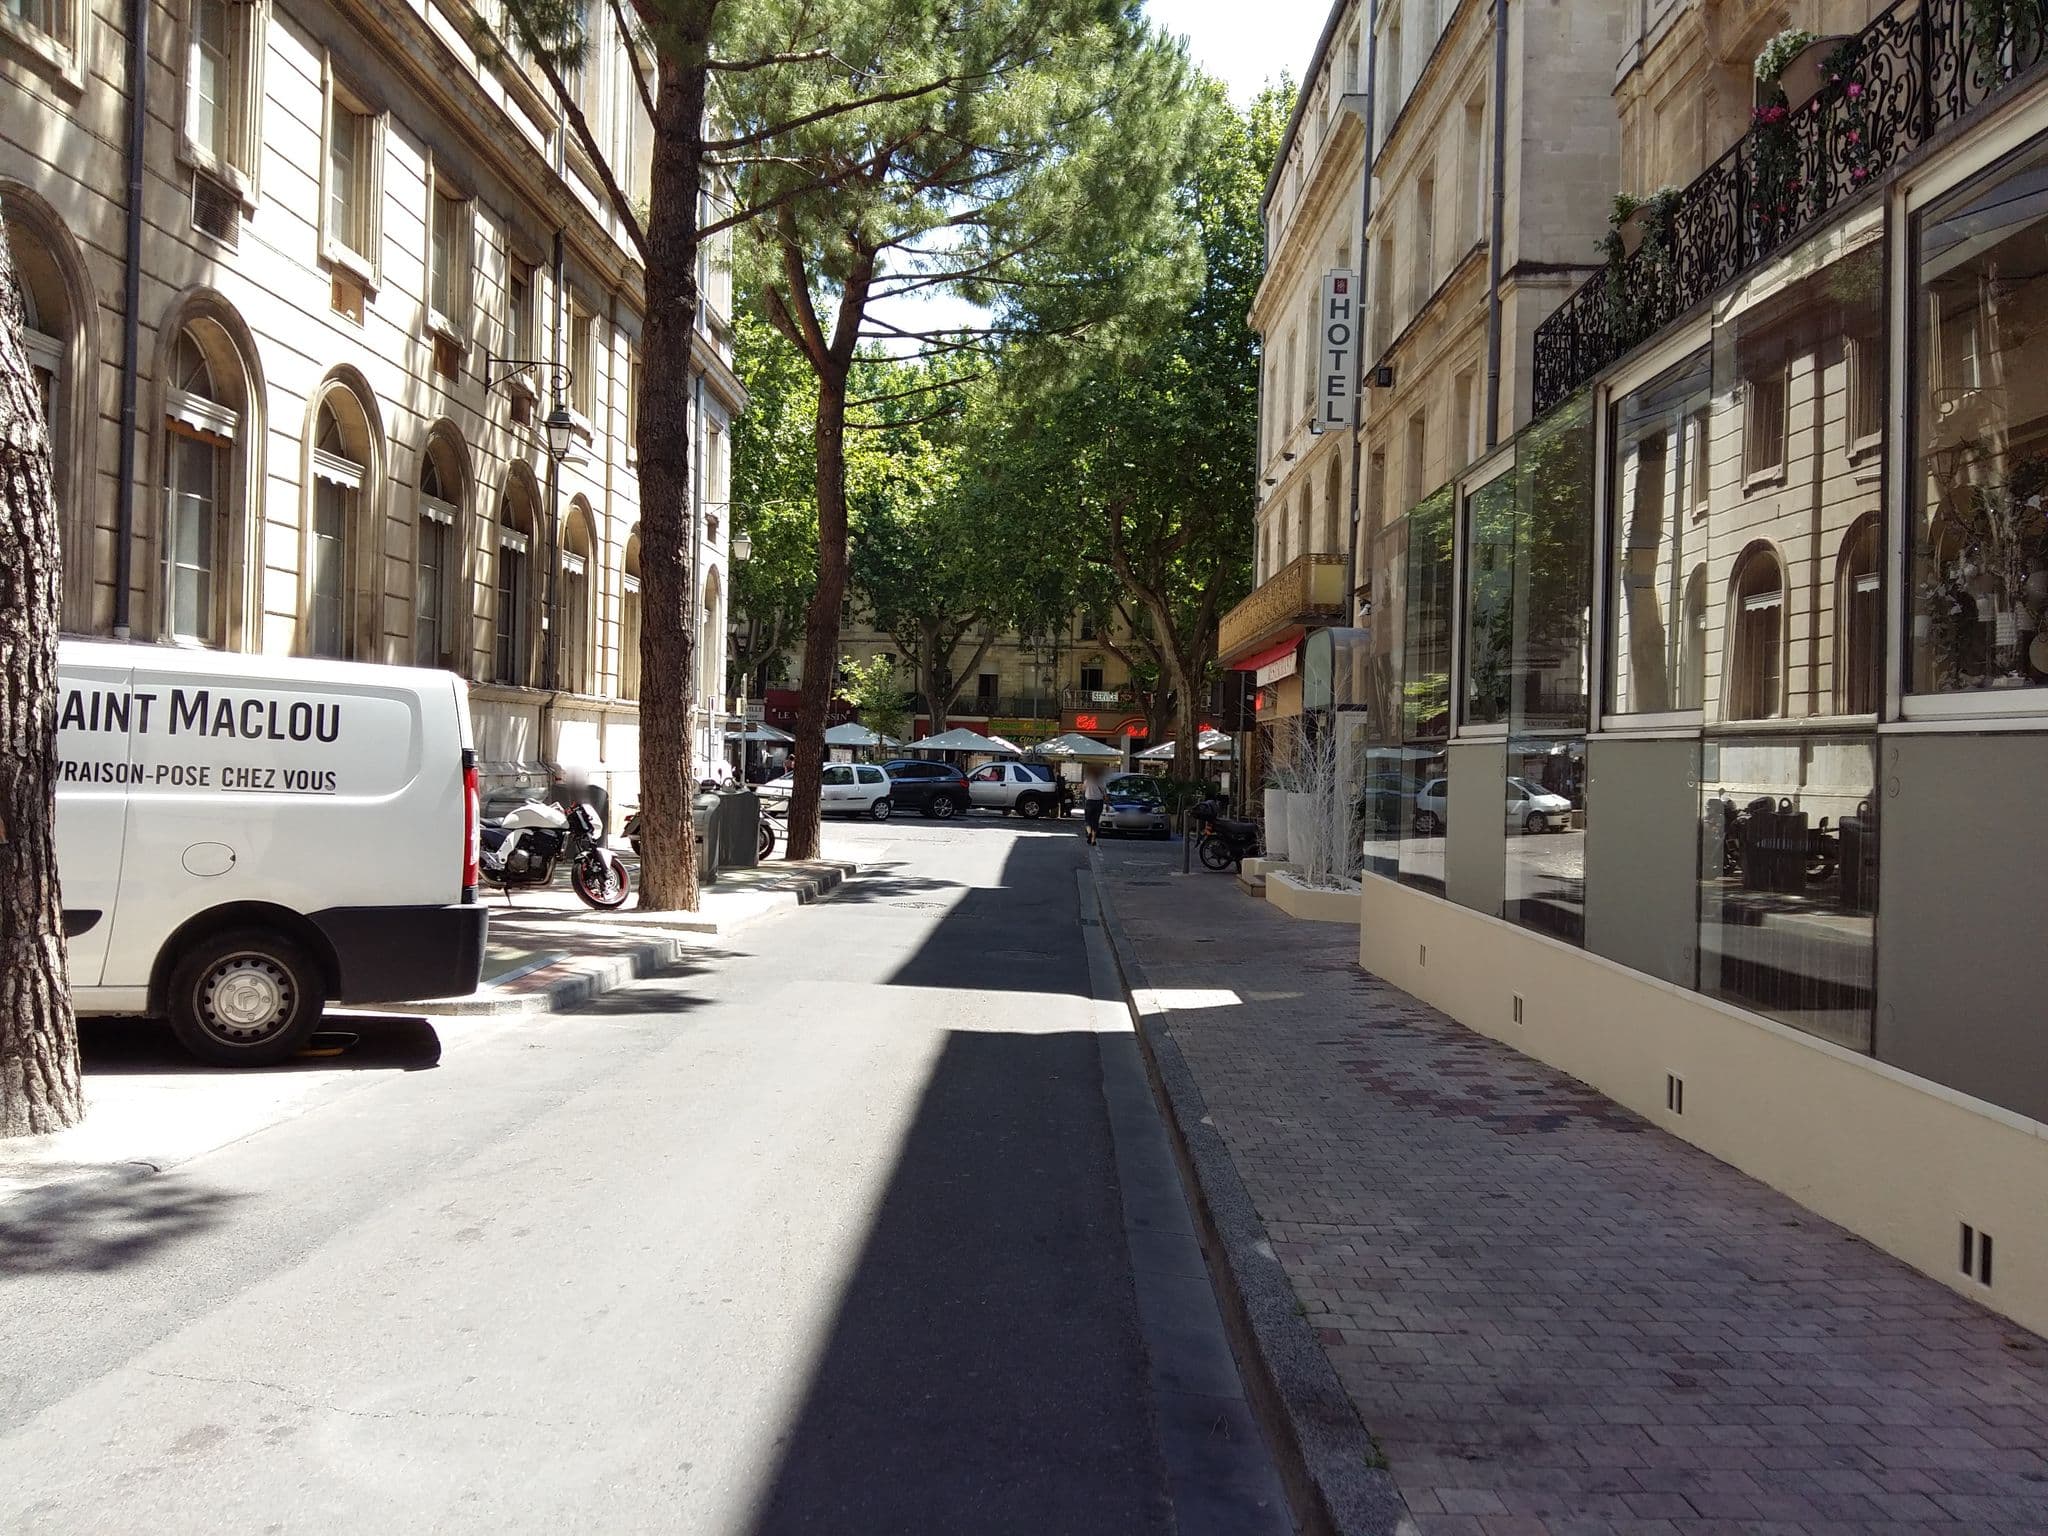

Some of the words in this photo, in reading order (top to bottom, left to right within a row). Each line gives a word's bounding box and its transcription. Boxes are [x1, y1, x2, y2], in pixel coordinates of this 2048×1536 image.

[1326, 298, 1350, 422] HOTEL
[57, 689, 157, 733] AINT
[168, 688, 340, 742] MACLOU
[221, 766, 276, 788] CHEZ
[283, 769, 336, 791] VOUS
